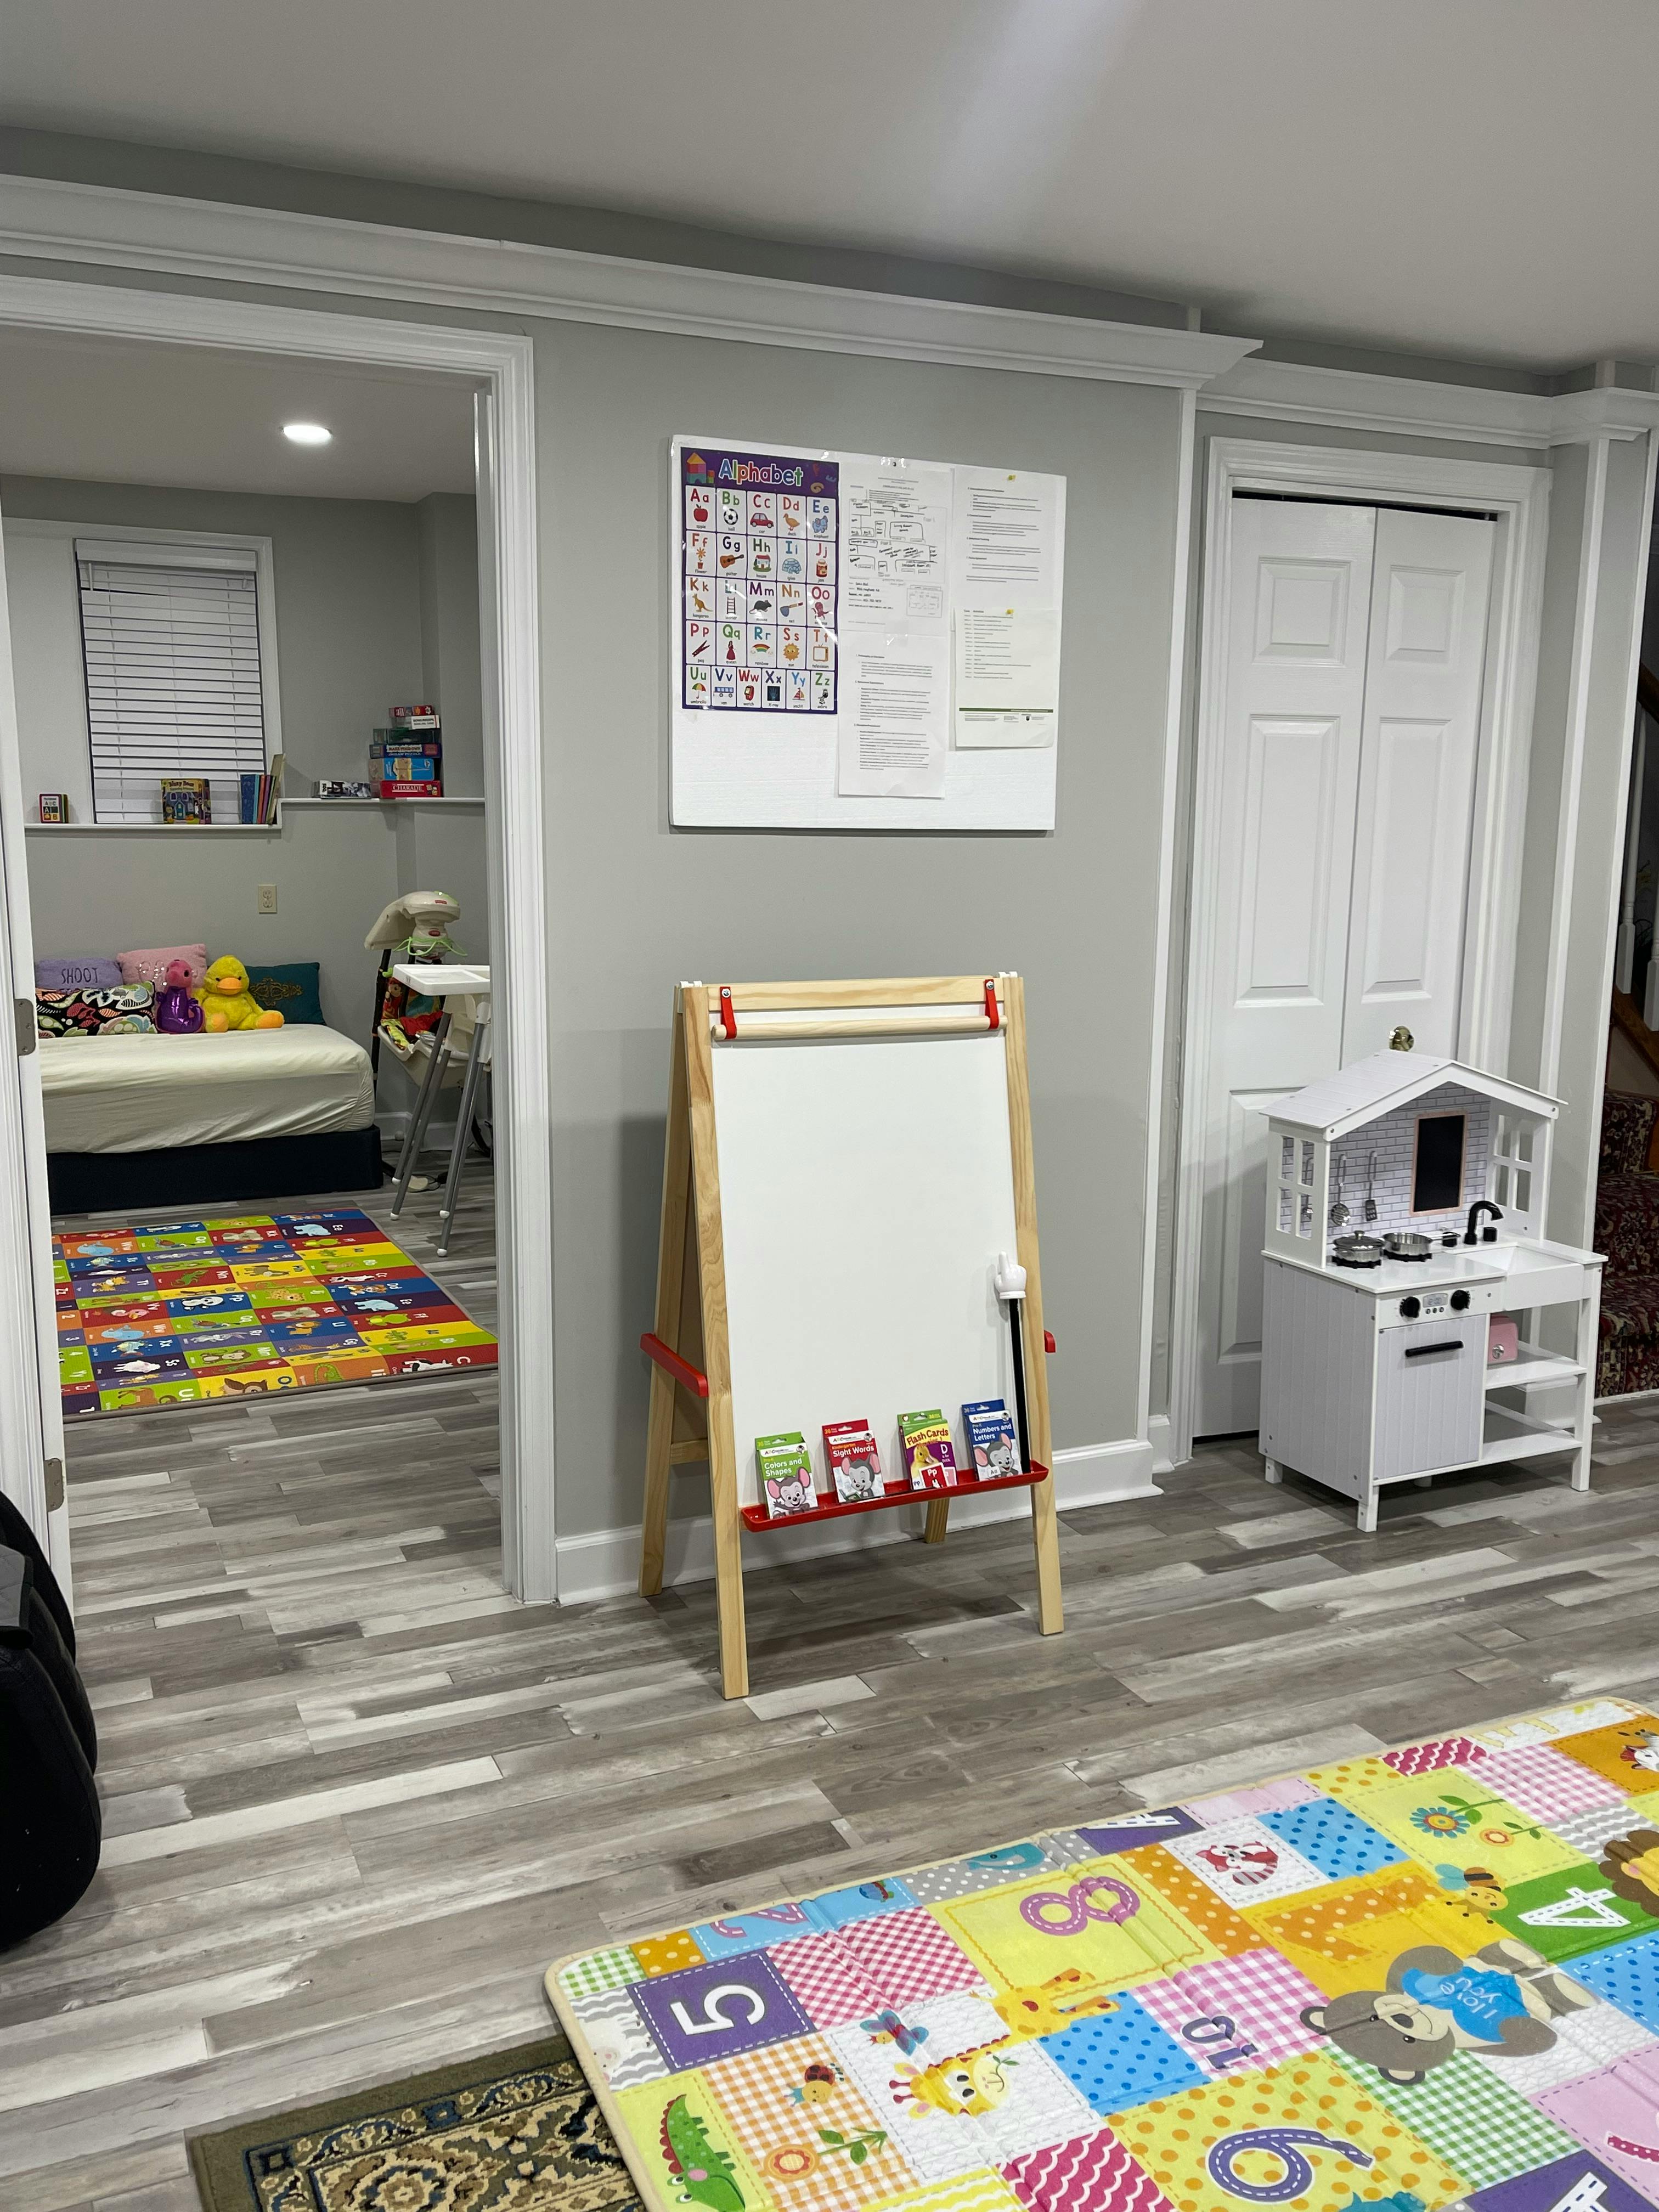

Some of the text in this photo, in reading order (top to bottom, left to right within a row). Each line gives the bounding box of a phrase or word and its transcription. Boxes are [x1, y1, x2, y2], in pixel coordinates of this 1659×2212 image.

[718, 458, 803, 487] Alphabet
[690, 488, 709, 503] Aa
[722, 491, 740, 505] Bb
[753, 494, 770, 508] Cc
[783, 496, 799, 511] Dd
[813, 499, 829, 514] Ee
[692, 533, 708, 547] Ff
[723, 536, 740, 552] Gg
[753, 538, 770, 552] Hh
[786, 540, 798, 555] Ii
[816, 543, 827, 558] Jj
[690, 577, 709, 592] Kk
[749, 582, 774, 596] Mm
[782, 584, 800, 598] Nn
[811, 586, 830, 600] Oo
[690, 623, 709, 637] Pp
[723, 624, 741, 640] Qq
[754, 626, 771, 640] Rr
[783, 627, 799, 641] Ss
[690, 667, 707, 680] Uu
[715, 668, 732, 681] Vv
[738, 669, 759, 682] Ww
[765, 670, 782, 684] Xx
[792, 672, 805, 687] Yy
[815, 673, 830, 686] Zz
[61, 967, 98, 985] SHOOT
[906, 1431, 927, 1446] Flash
[926, 1427, 949, 1438] Cards
[973, 1426, 1000, 1435] Numbers
[974, 1434, 996, 1442] Letters
[833, 1446, 874, 1458] Sight Words
[940, 1443, 948, 1454] D
[764, 1457, 803, 1470] Colors and
[765, 1467, 792, 1477] Shapes
[1019, 1875, 1141, 1936] 8
[1517, 1887, 1632, 1928] 4
[1440, 1982, 1486, 2013] love
[1455, 1977, 1503, 2004] you
[669, 1984, 766, 2036] 5
[1181, 2015, 1260, 2070] 10
